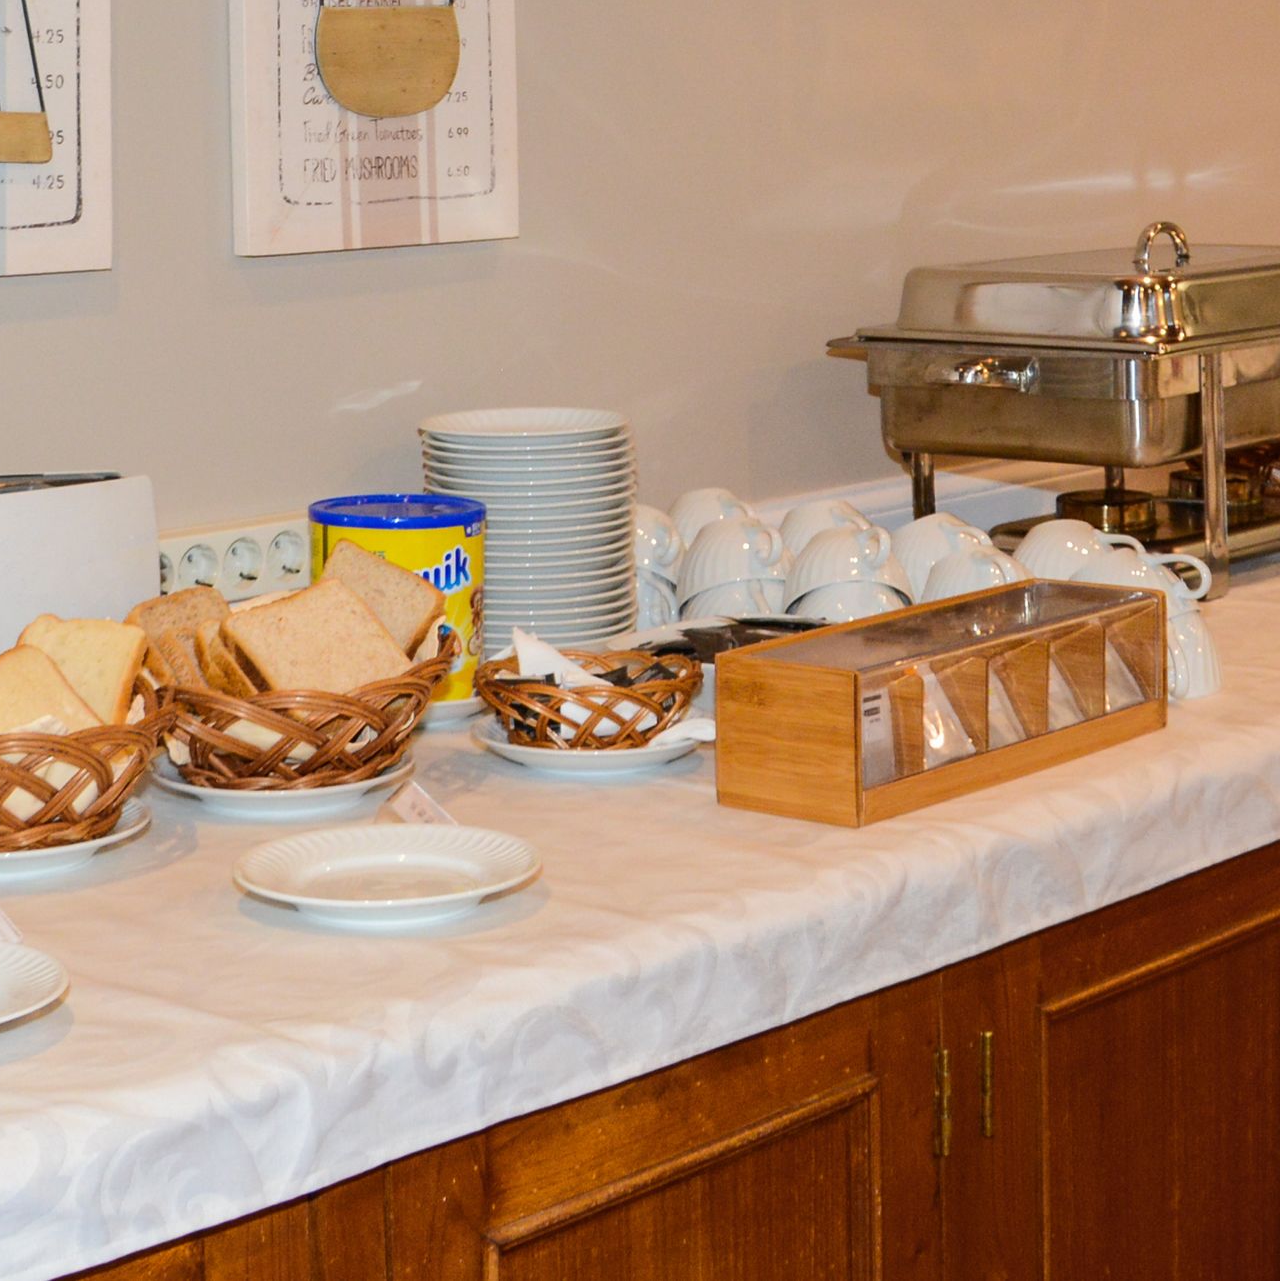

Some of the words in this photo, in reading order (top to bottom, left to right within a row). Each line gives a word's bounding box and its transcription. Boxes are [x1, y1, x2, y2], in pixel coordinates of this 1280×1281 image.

[369, 117, 423, 141] Tomatoes
[447, 126, 469, 139] 6.99
[303, 157, 337, 183] FRIED
[344, 155, 419, 182] MUSHROOMS
[32, 174, 65, 191] 4.25
